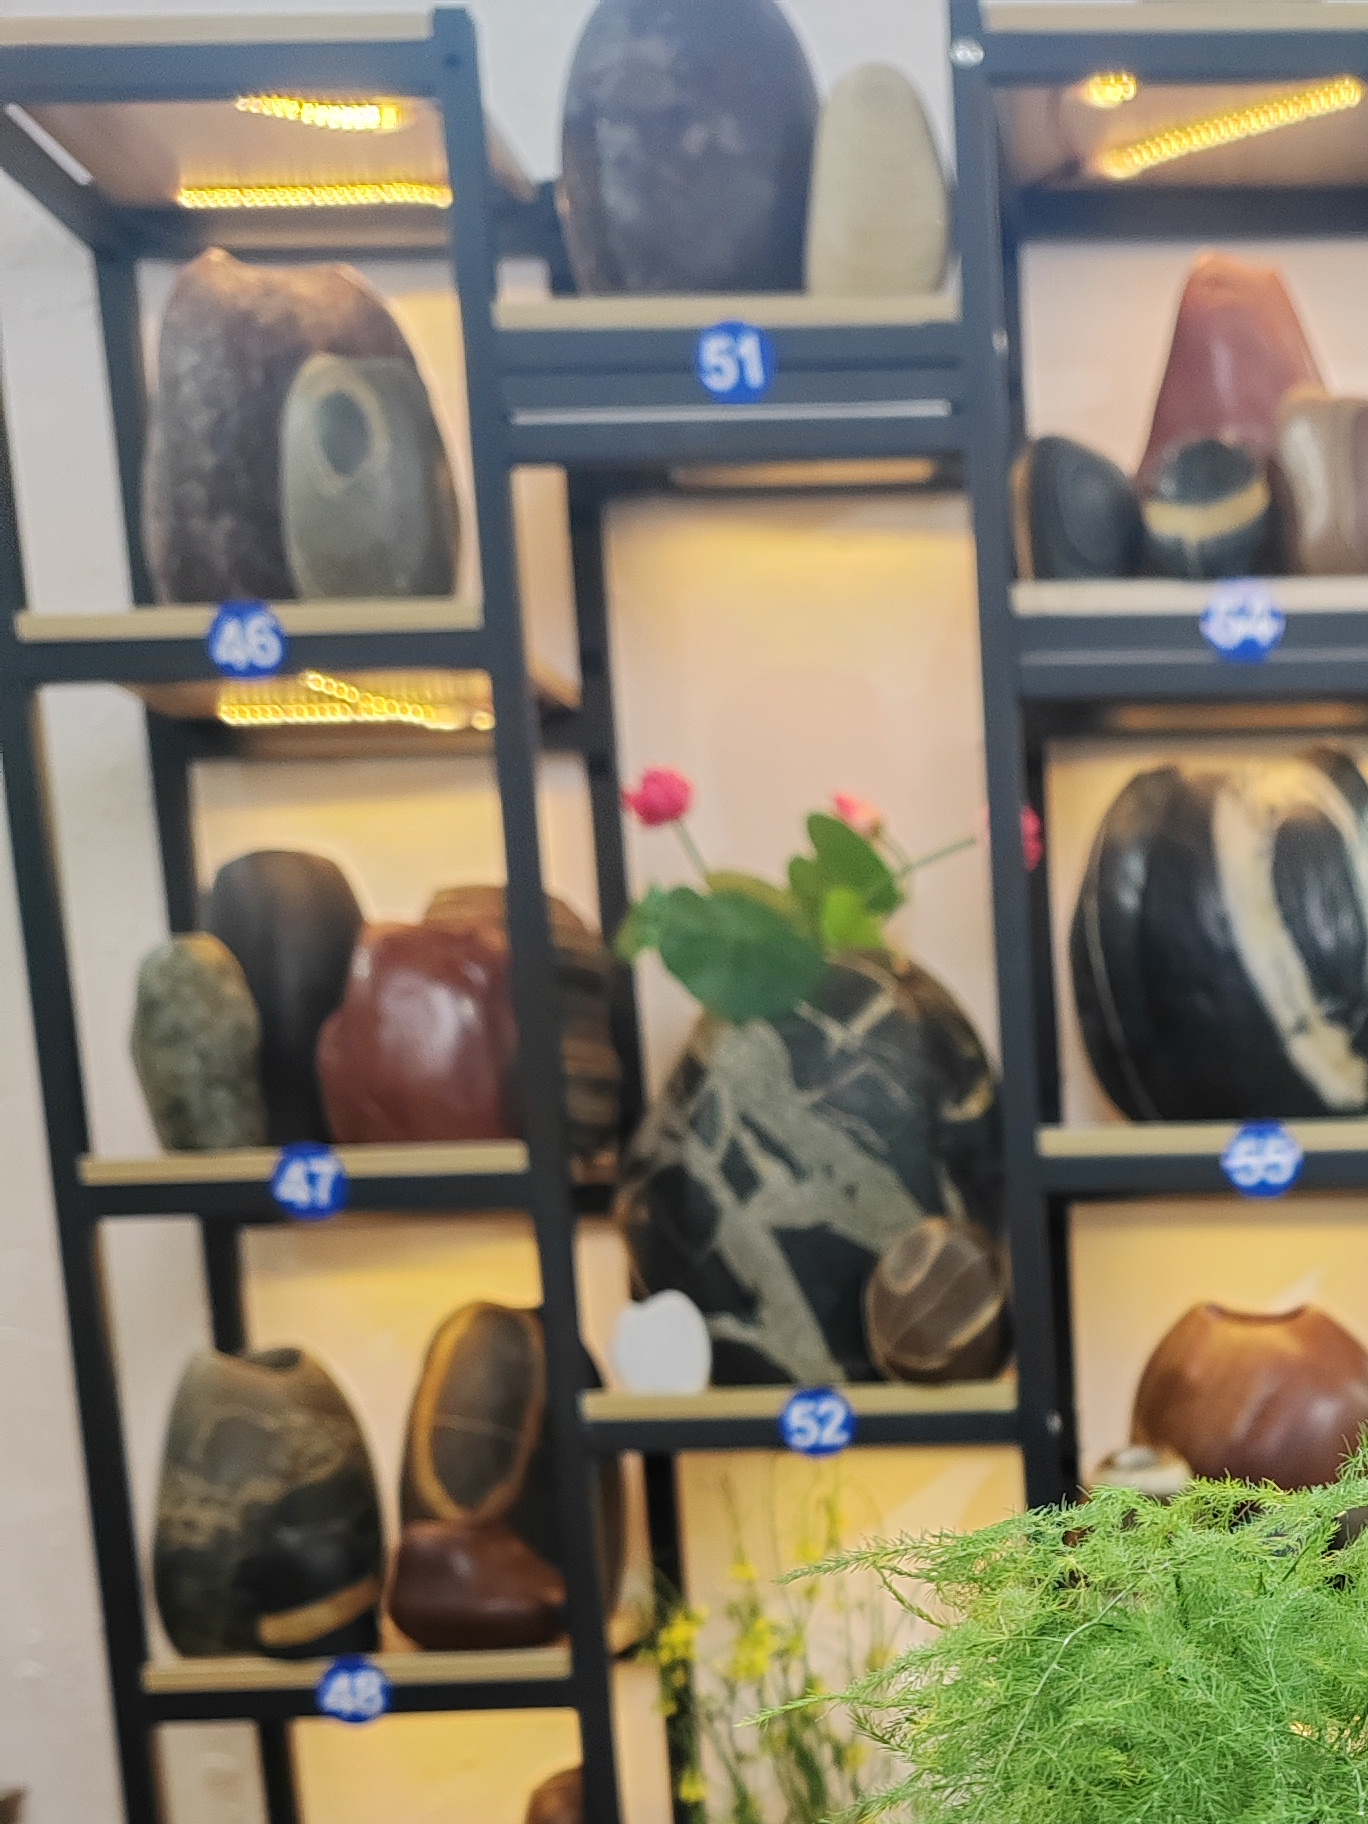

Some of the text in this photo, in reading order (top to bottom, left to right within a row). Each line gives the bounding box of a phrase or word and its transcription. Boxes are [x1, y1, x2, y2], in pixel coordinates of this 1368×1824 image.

[701, 333, 764, 392] 51
[212, 616, 283, 668] 46
[275, 1160, 340, 1206] 47
[1225, 1138, 1299, 1186] 55
[787, 1395, 849, 1446] 52
[322, 1670, 385, 1716] 48
